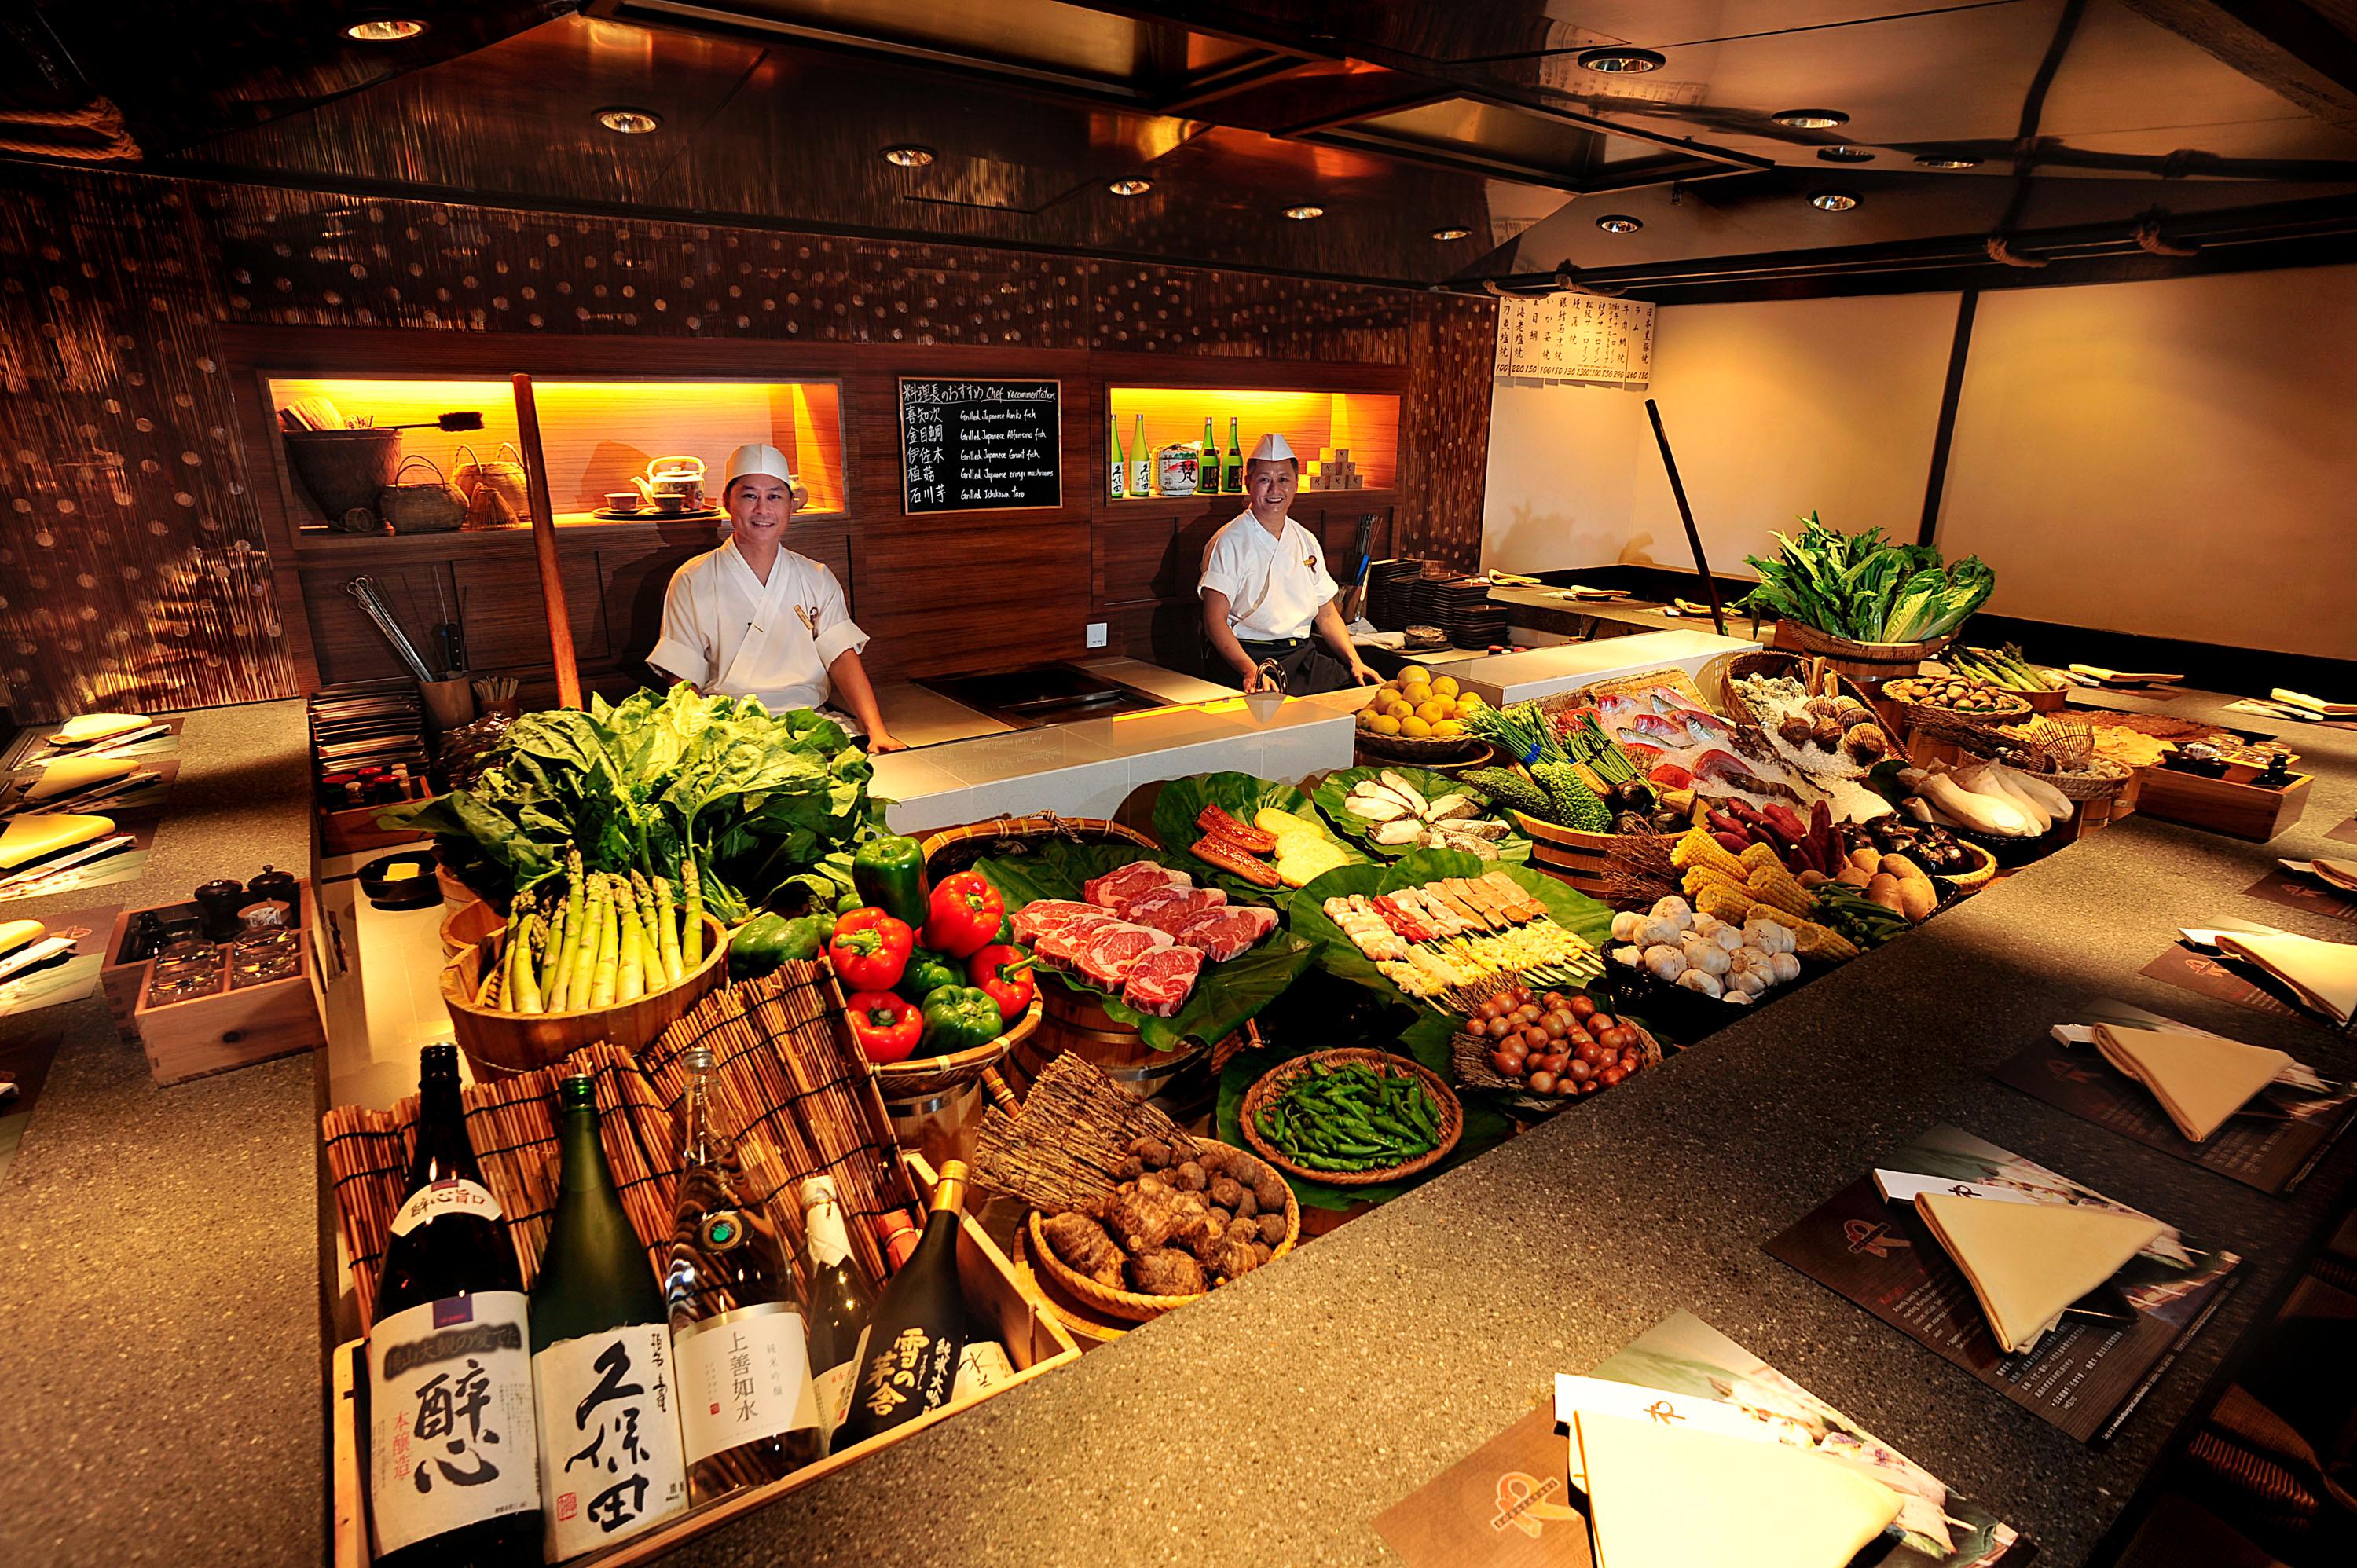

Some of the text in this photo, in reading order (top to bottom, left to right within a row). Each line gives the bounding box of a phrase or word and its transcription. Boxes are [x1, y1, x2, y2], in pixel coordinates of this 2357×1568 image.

[1512, 365, 1525, 373] 220
[1525, 365, 1538, 373] 150
[1540, 366, 1552, 375] 100
[903, 383, 984, 403] 料理長のおすすめ
[986, 386, 1003, 403] Chef
[905, 405, 943, 425] 喜知次
[960, 410, 981, 421] Grilled
[981, 409, 1005, 423] Japanese
[1023, 408, 1036, 422] fish
[907, 424, 943, 445] 金目鯛
[960, 428, 981, 441] Grilled
[981, 429, 1005, 445] Japanese
[1035, 427, 1047, 441] fish
[906, 446, 944, 464] 伊佐木
[961, 449, 982, 460] Grilled
[983, 449, 1006, 463] Japanese
[1026, 449, 1041, 460] fish
[960, 467, 982, 480] Grilled
[984, 468, 1007, 483] Japanese
[1027, 468, 1054, 478] mushrooms
[910, 483, 946, 504] 石川芋
[961, 489, 981, 500] Grilled
[728, 1332, 759, 1423] 上善如水
[564, 1339, 651, 1533] 久保田
